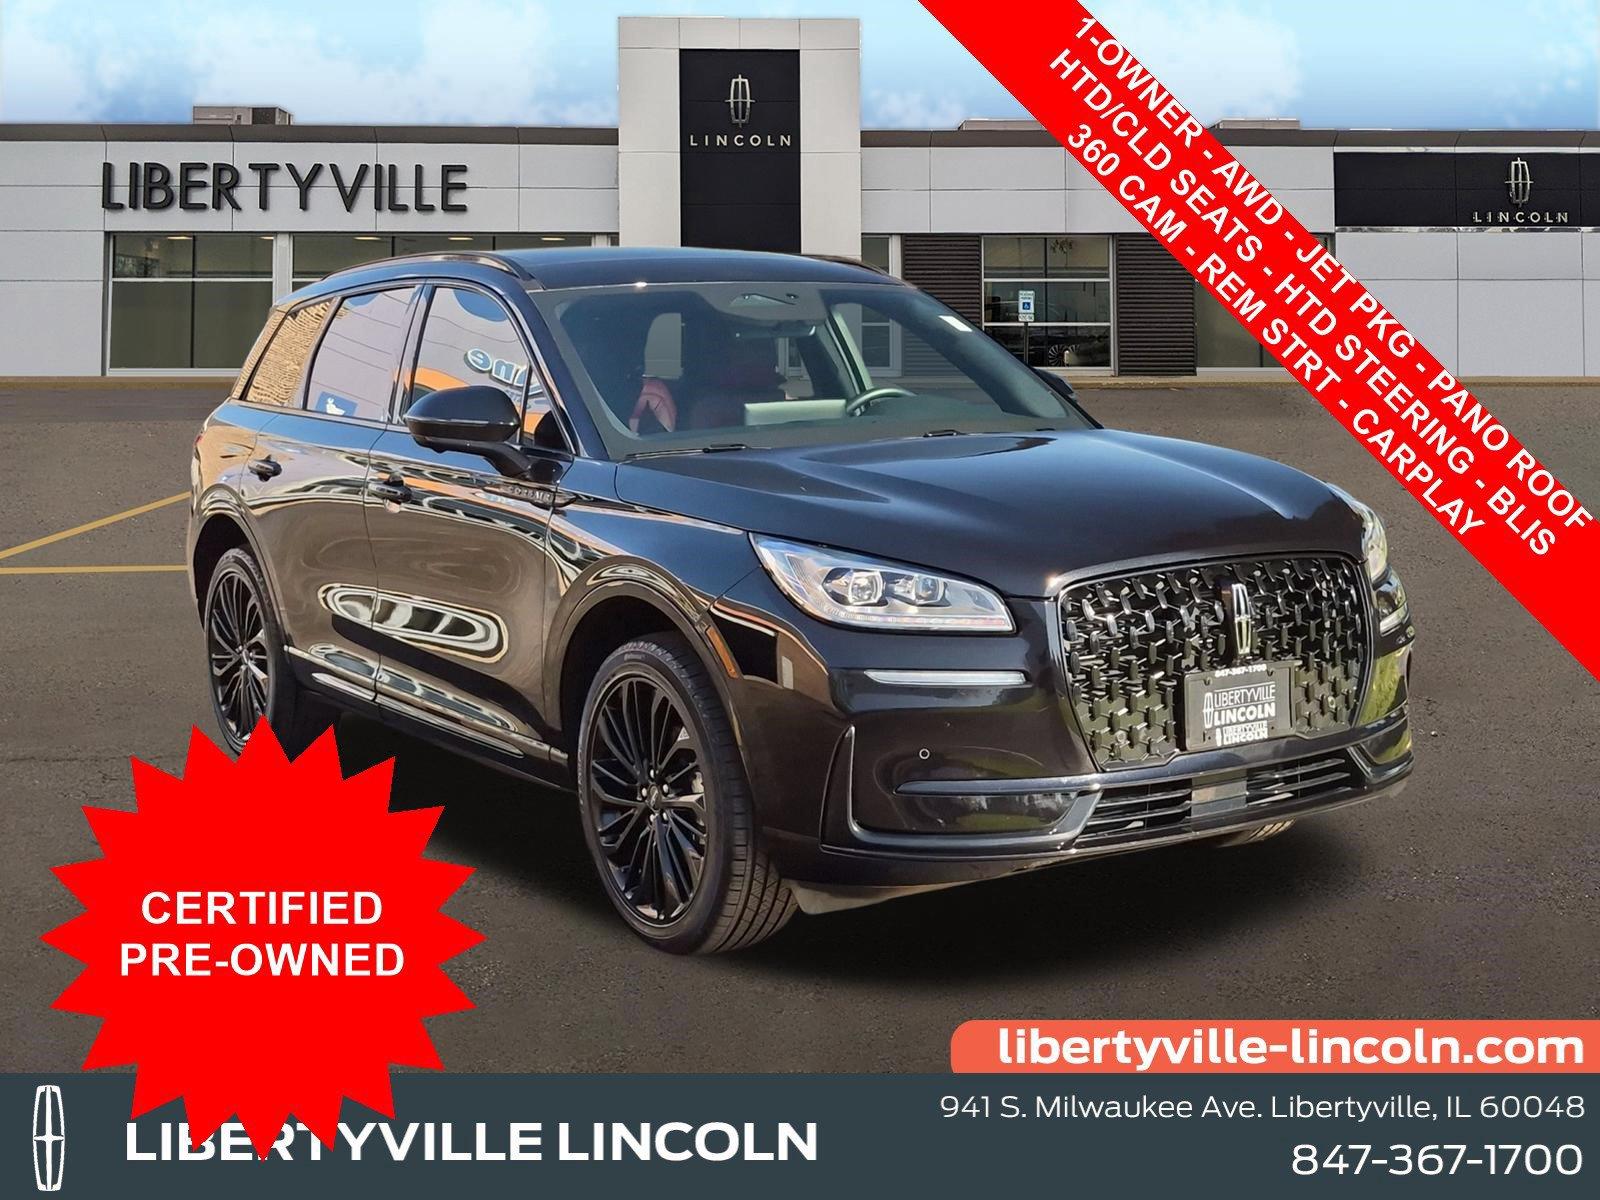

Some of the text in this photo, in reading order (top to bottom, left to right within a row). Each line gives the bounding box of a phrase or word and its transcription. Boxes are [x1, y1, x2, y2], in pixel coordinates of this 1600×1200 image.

[690, 134, 791, 147] LINCOLN
[101, 160, 470, 213] LIBERTYVILLE
[1473, 211, 1568, 224] LINCOLN
[1213, 684, 1276, 708] LIBERTYVILLE
[1213, 702, 1276, 726] LINCOLN
[1223, 730, 1269, 746] LINCOLN
